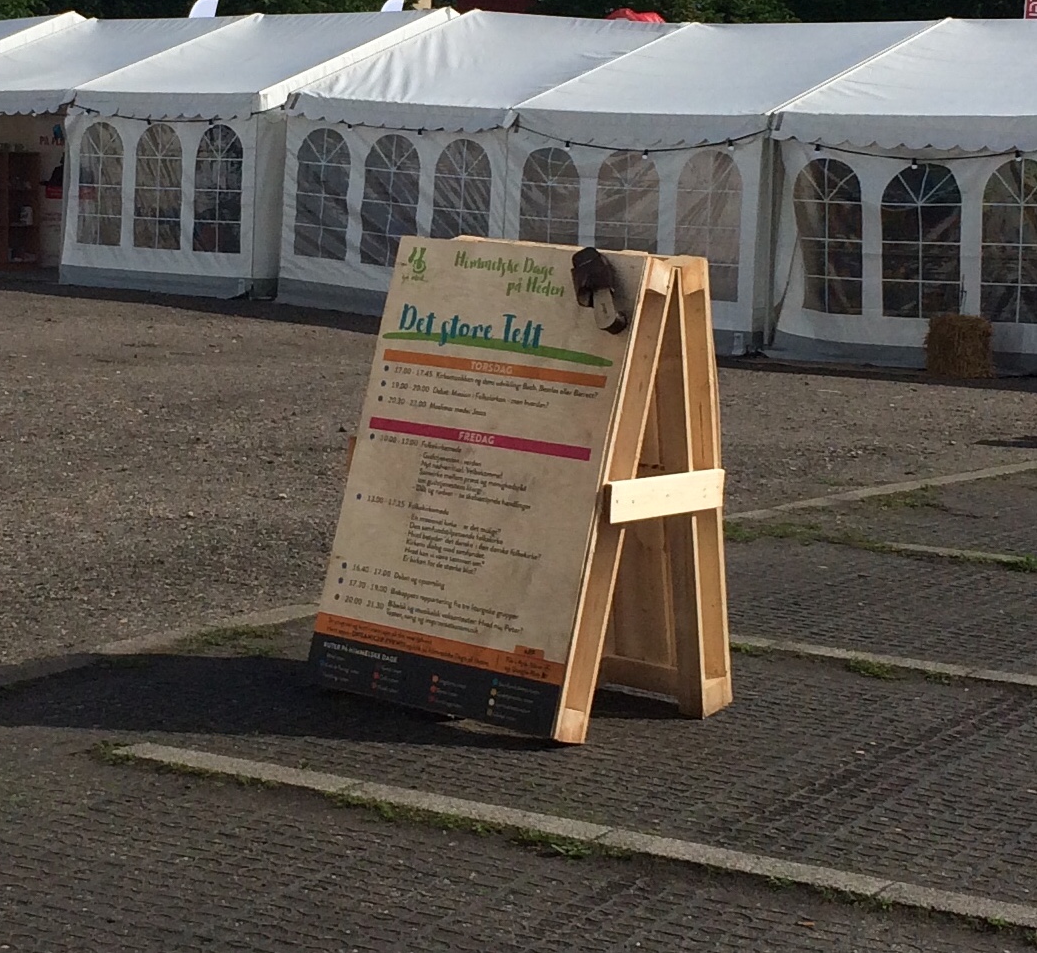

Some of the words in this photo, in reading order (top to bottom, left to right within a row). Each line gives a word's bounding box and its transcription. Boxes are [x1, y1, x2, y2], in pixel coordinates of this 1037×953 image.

[455, 251, 519, 277] Himmelske
[523, 257, 554, 282] Dage
[506, 279, 521, 296] på
[526, 277, 564, 297] Heden
[399, 304, 435, 335] Det
[439, 315, 493, 346] store
[502, 314, 544, 349] Telt
[469, 361, 513, 374] TORSDAG
[457, 431, 495, 445] FREDAG
